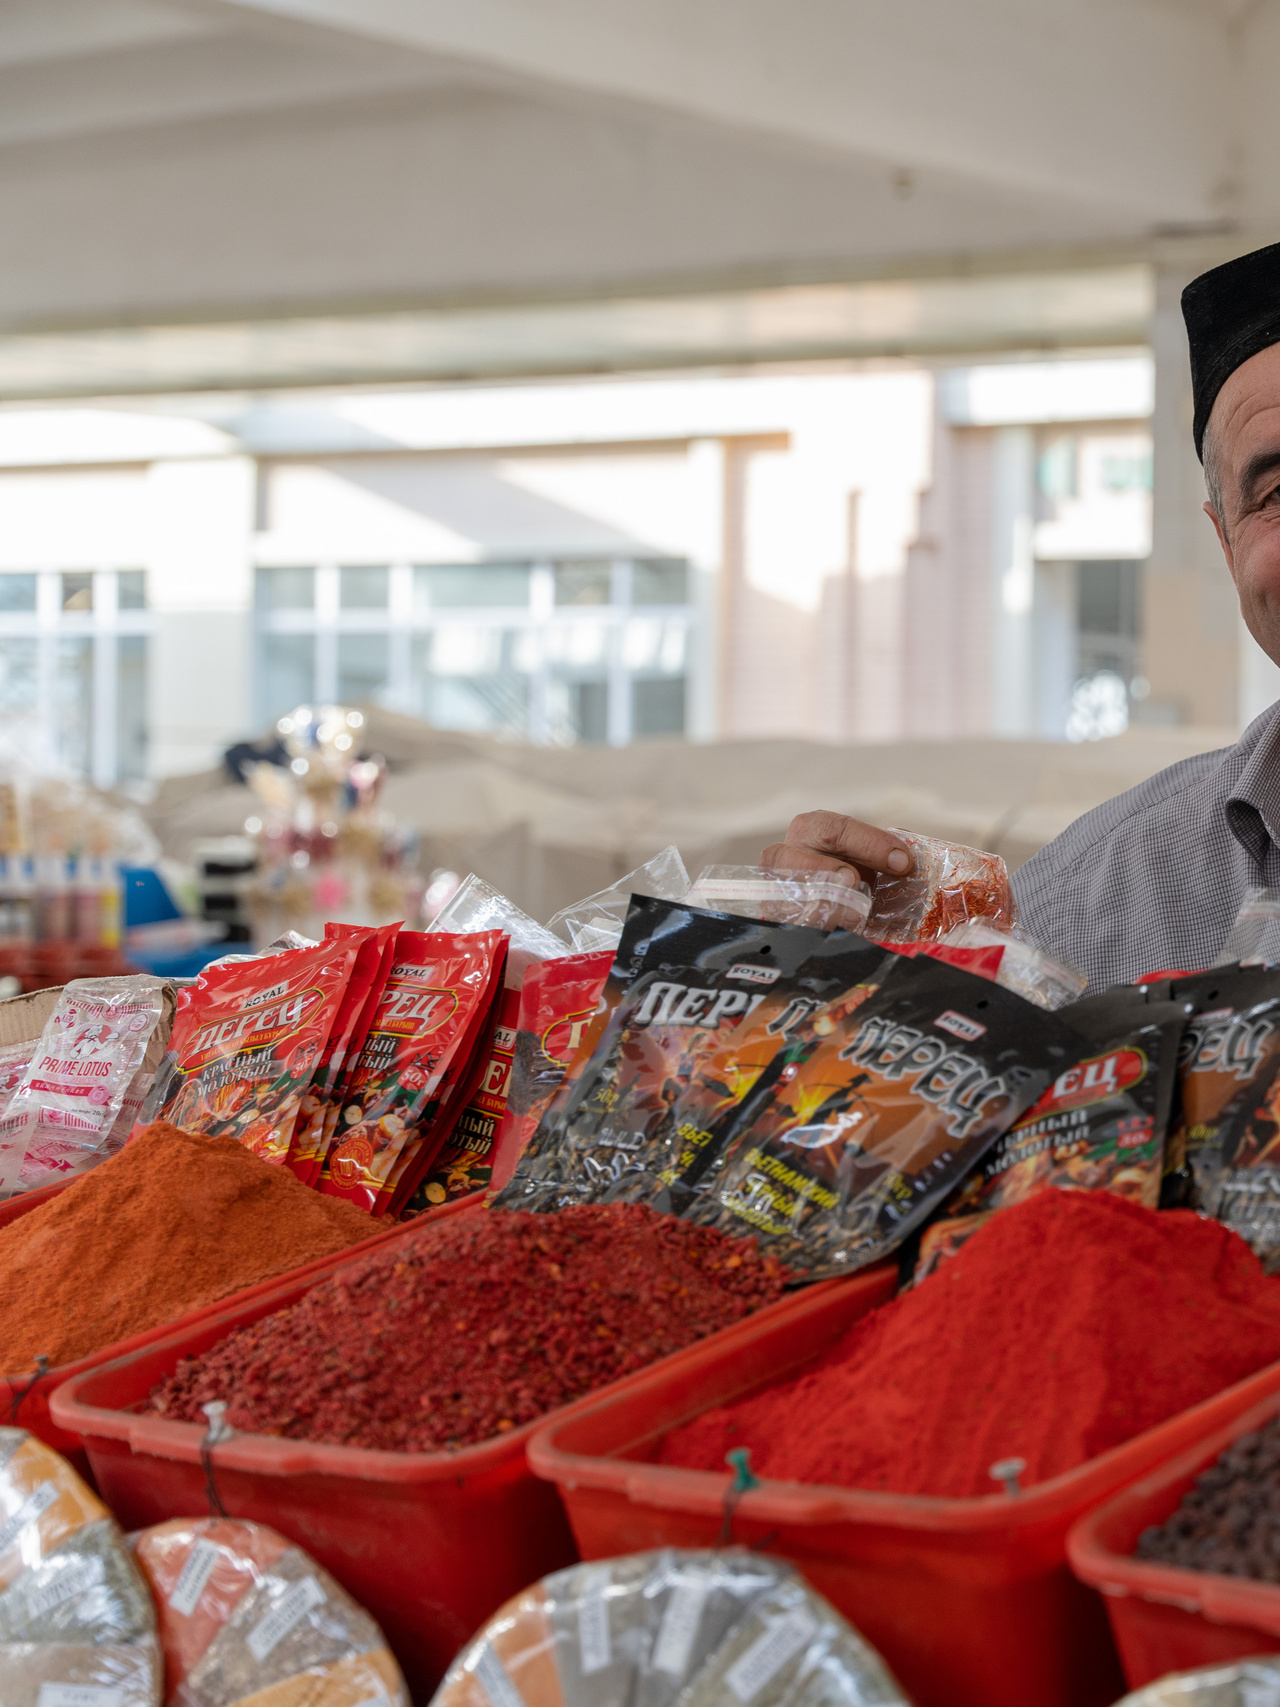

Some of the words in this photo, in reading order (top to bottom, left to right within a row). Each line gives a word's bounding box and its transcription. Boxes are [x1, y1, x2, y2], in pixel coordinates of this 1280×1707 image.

[390, 967, 427, 977] ROYAL
[732, 967, 775, 980] ROYAL
[244, 987, 284, 1009] ROYAL
[380, 990, 445, 1031] РЕЦ
[634, 981, 766, 1029] ПЕР
[189, 993, 307, 1056] ПЕРЕЦ
[39, 1056, 79, 1076] PRIME
[77, 1061, 113, 1077] LOTUS
[203, 1045, 273, 1081] КРАСНЫЙ
[1178, 1020, 1274, 1081] РЕЦ
[197, 1060, 273, 1097] МОЛОТЫЙ
[838, 1016, 1005, 1139] ПЕРЕЦ
